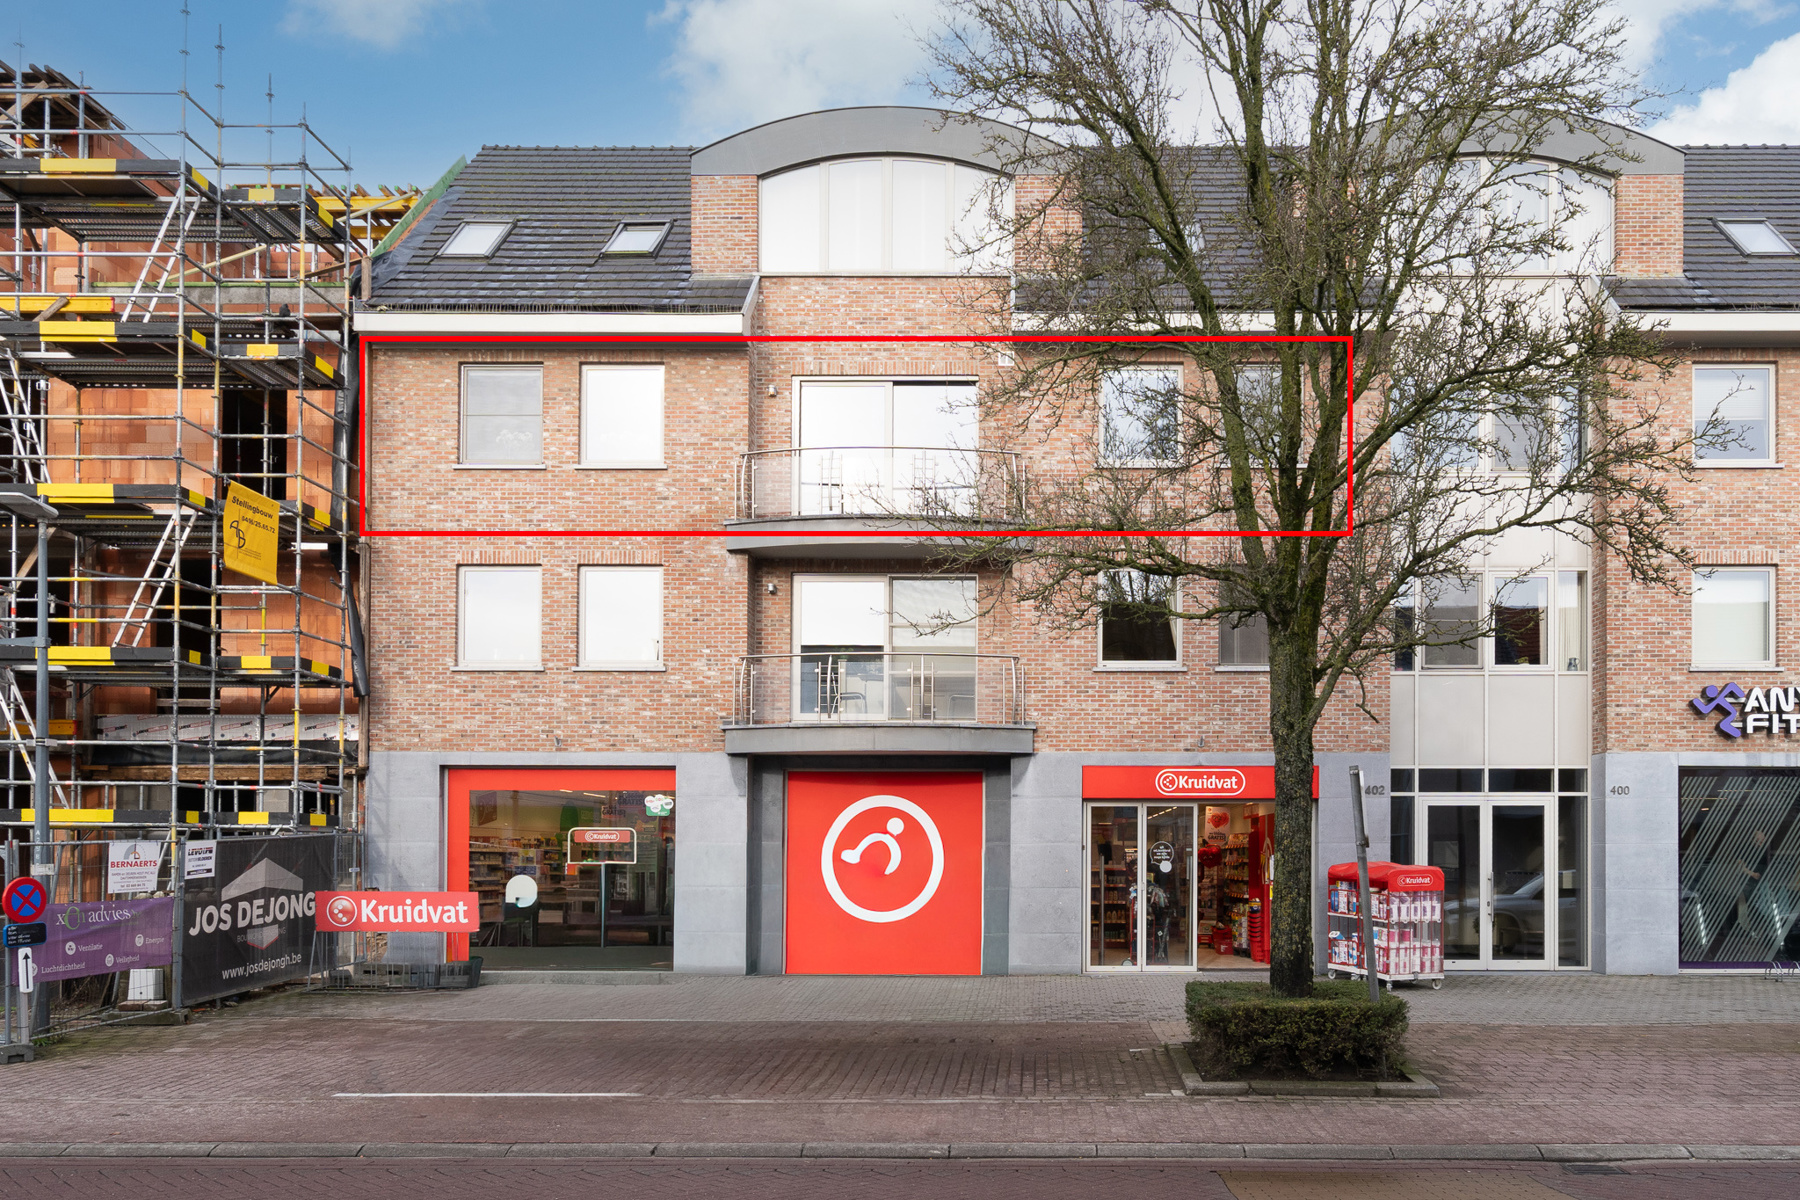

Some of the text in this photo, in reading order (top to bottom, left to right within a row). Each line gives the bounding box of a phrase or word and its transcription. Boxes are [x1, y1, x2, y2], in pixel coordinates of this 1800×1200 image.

[231, 496, 274, 520] Stellingbouw
[1744, 687, 1800, 712] AN
[1747, 714, 1800, 733] FIT
[1178, 775, 1238, 789] Kruidvat
[1365, 785, 1385, 796] 402
[1610, 785, 1630, 796] 400
[110, 860, 158, 868] BERNAERTS
[1405, 876, 1431, 884] Kruidvat
[88, 905, 132, 923] advies
[360, 898, 469, 924] Kruidvat
[188, 903, 233, 936] JOS
[145, 936, 165, 945] Energie
[77, 943, 104, 952] Ventilatie
[115, 954, 140, 964] Veiligheid
[41, 961, 86, 974] Luchtdichtheid
[221, 952, 302, 980] www.josdejongh.be
